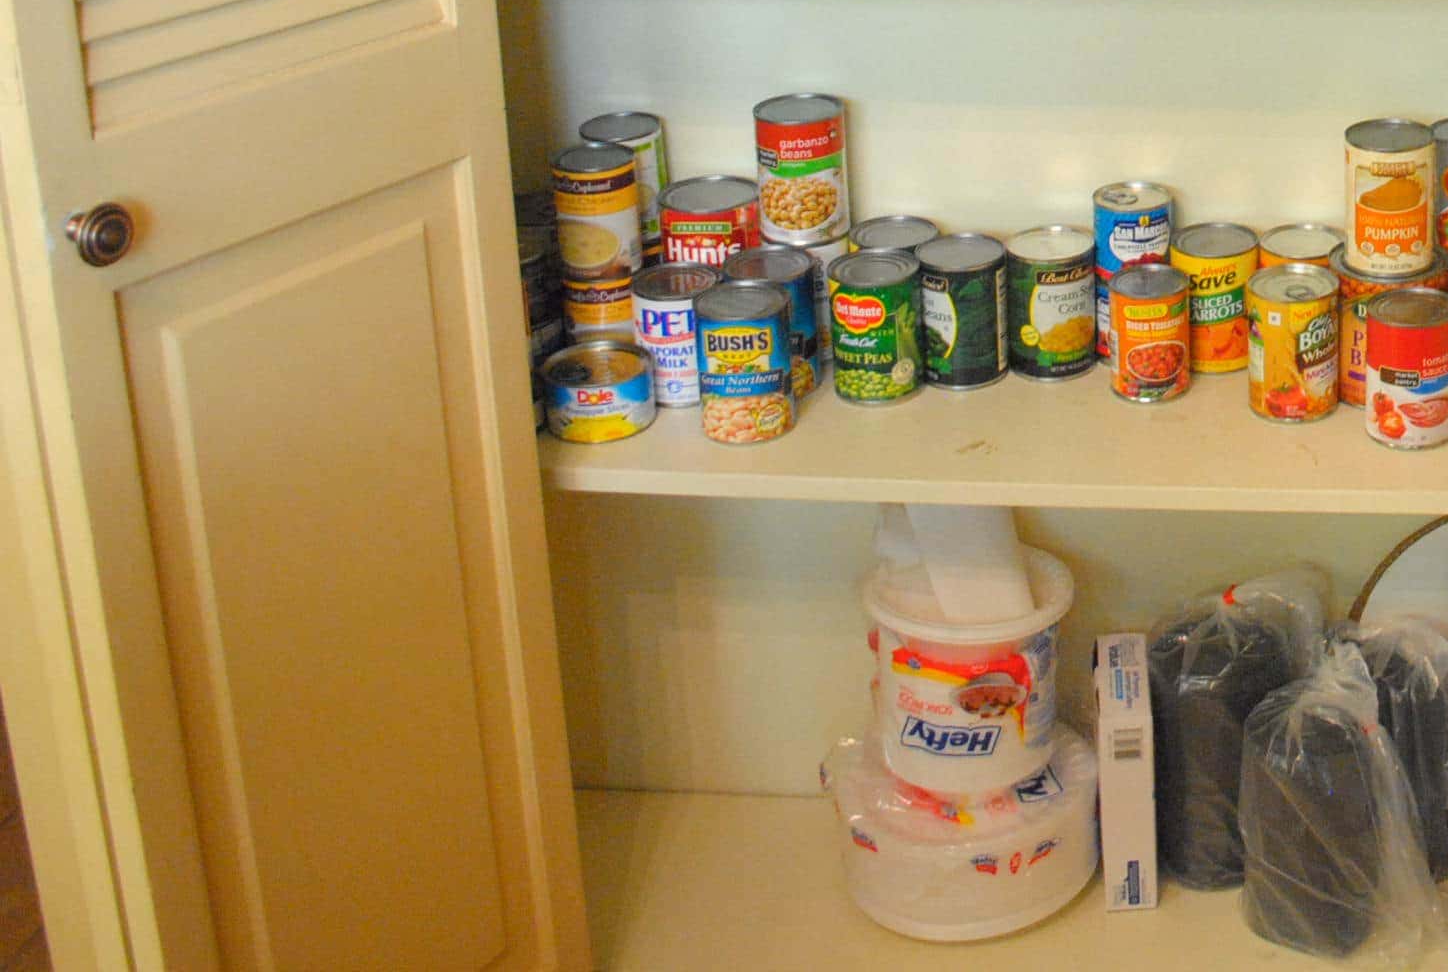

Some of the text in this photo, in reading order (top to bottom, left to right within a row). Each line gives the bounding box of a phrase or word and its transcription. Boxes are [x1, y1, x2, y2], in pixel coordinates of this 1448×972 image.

[779, 135, 829, 149] garbanzo
[779, 148, 813, 159] beans
[1364, 226, 1419, 241] PUMPKIN
[1189, 270, 1237, 291] Save
[1058, 300, 1087, 315] Corn
[1191, 293, 1233, 310] SLICED
[849, 304, 882, 317] Monte
[1191, 303, 1243, 321] ARROTS
[707, 331, 769, 352] BUSH'S
[657, 357, 689, 369] MILK
[864, 353, 893, 365] PEAS
[577, 389, 614, 405] Dole
[909, 720, 994, 752] Hefty
